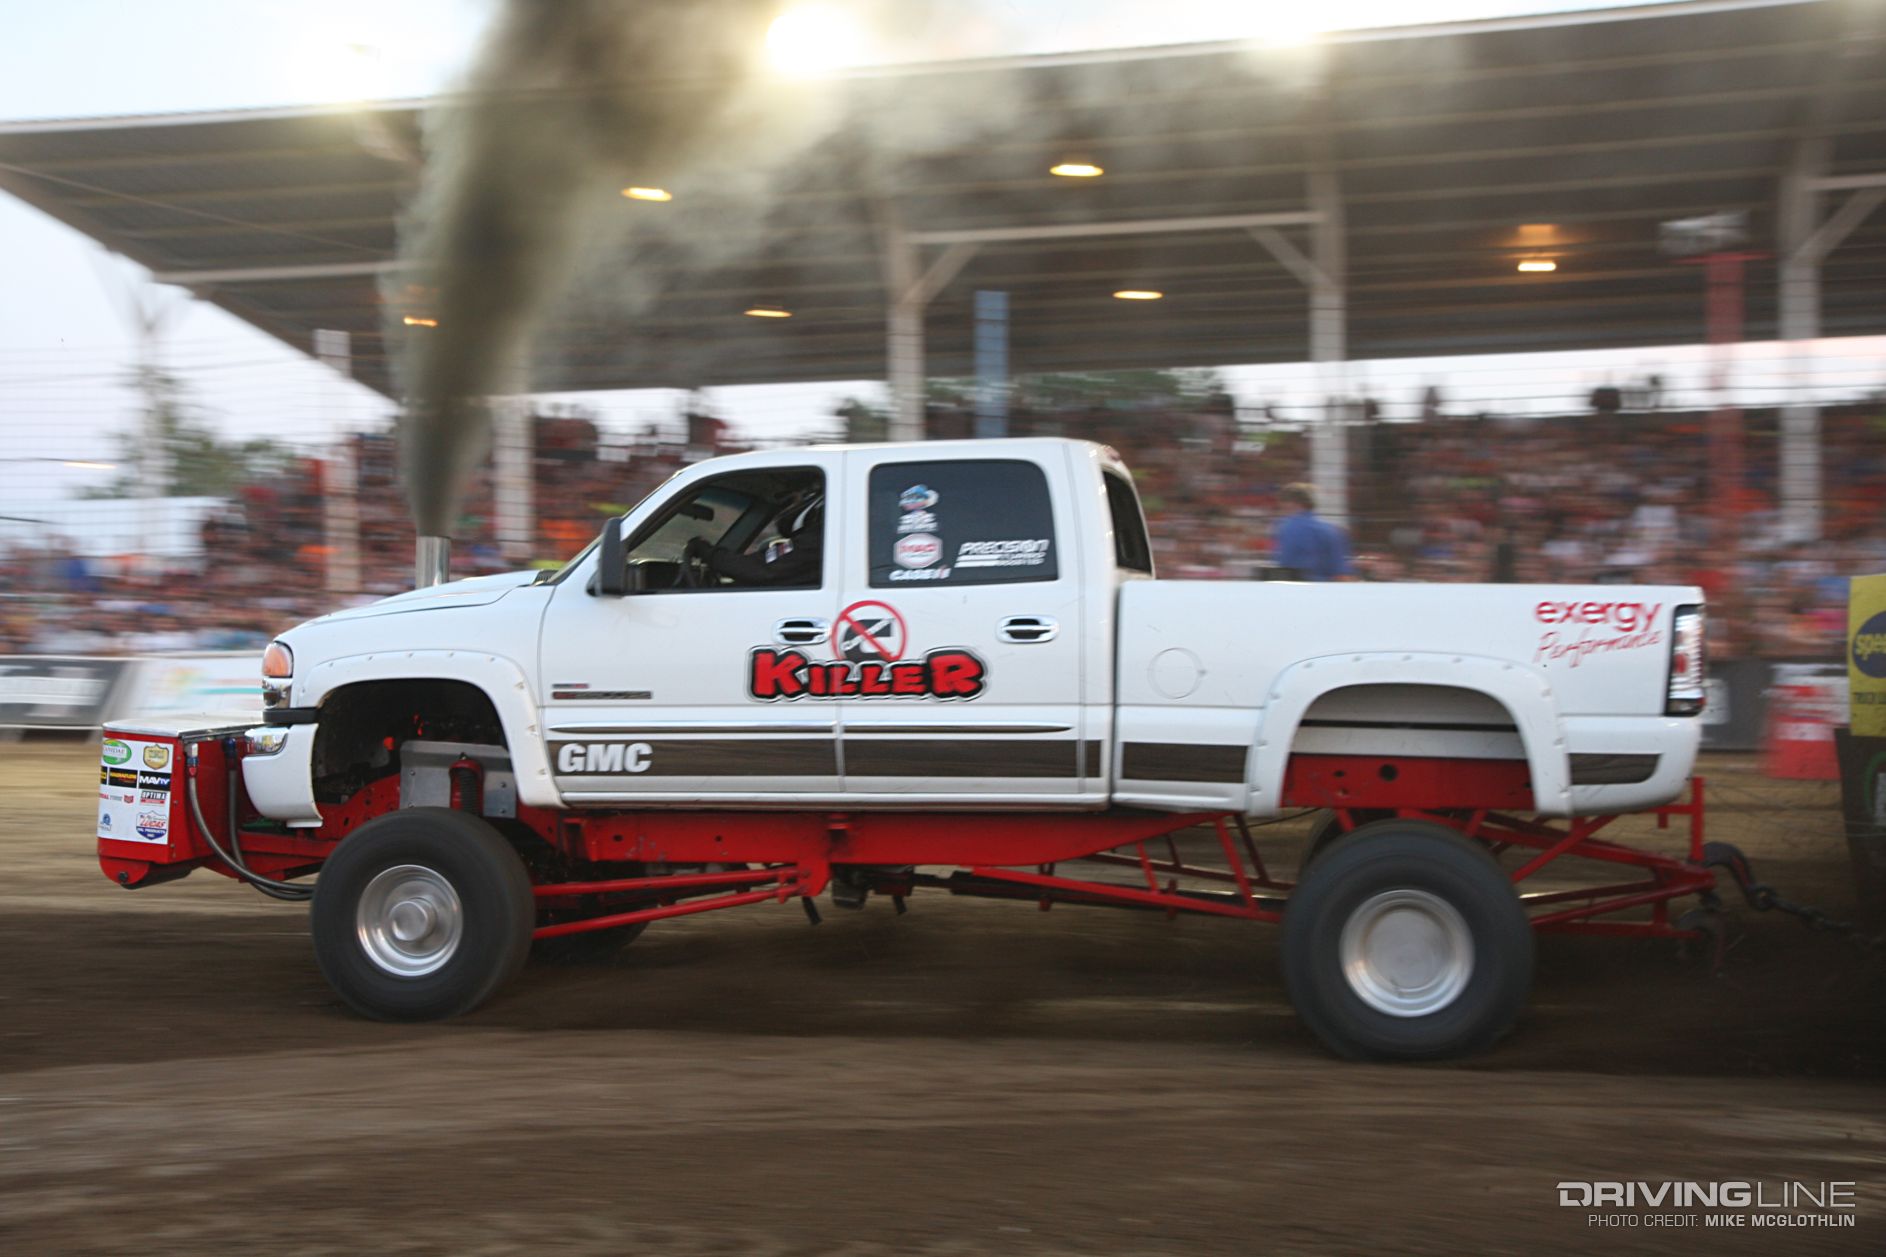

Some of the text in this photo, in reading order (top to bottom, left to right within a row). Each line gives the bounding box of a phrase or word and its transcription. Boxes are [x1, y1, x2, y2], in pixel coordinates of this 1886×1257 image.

[958, 539, 1050, 555] PRECISION
[1535, 602, 1661, 632] exergy
[558, 743, 653, 772] GMC
